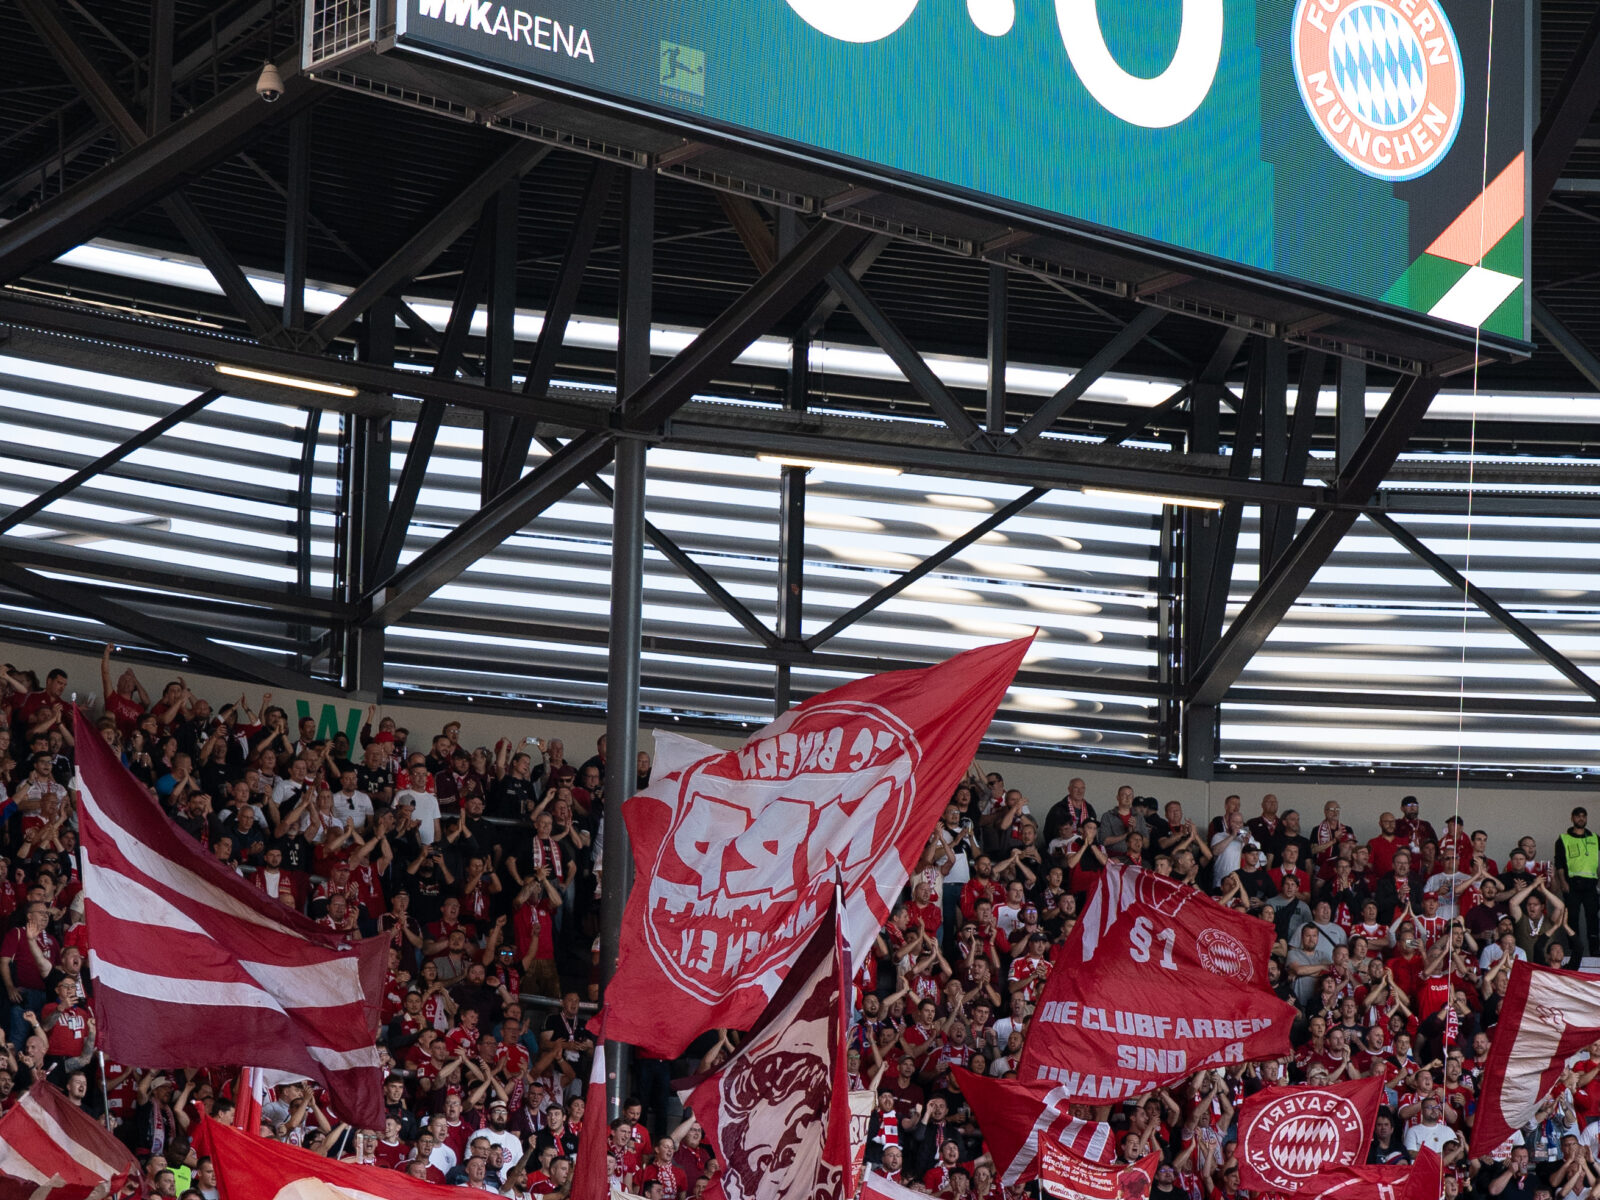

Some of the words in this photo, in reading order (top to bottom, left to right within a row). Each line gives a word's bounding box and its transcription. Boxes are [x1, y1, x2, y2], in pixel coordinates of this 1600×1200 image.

[1307, 70, 1448, 165] MÜNCHEN
[1040, 1001, 1078, 1024] DIE
[1081, 1006, 1272, 1039] CLUBFARBEN
[1117, 1044, 1186, 1074] SIND
